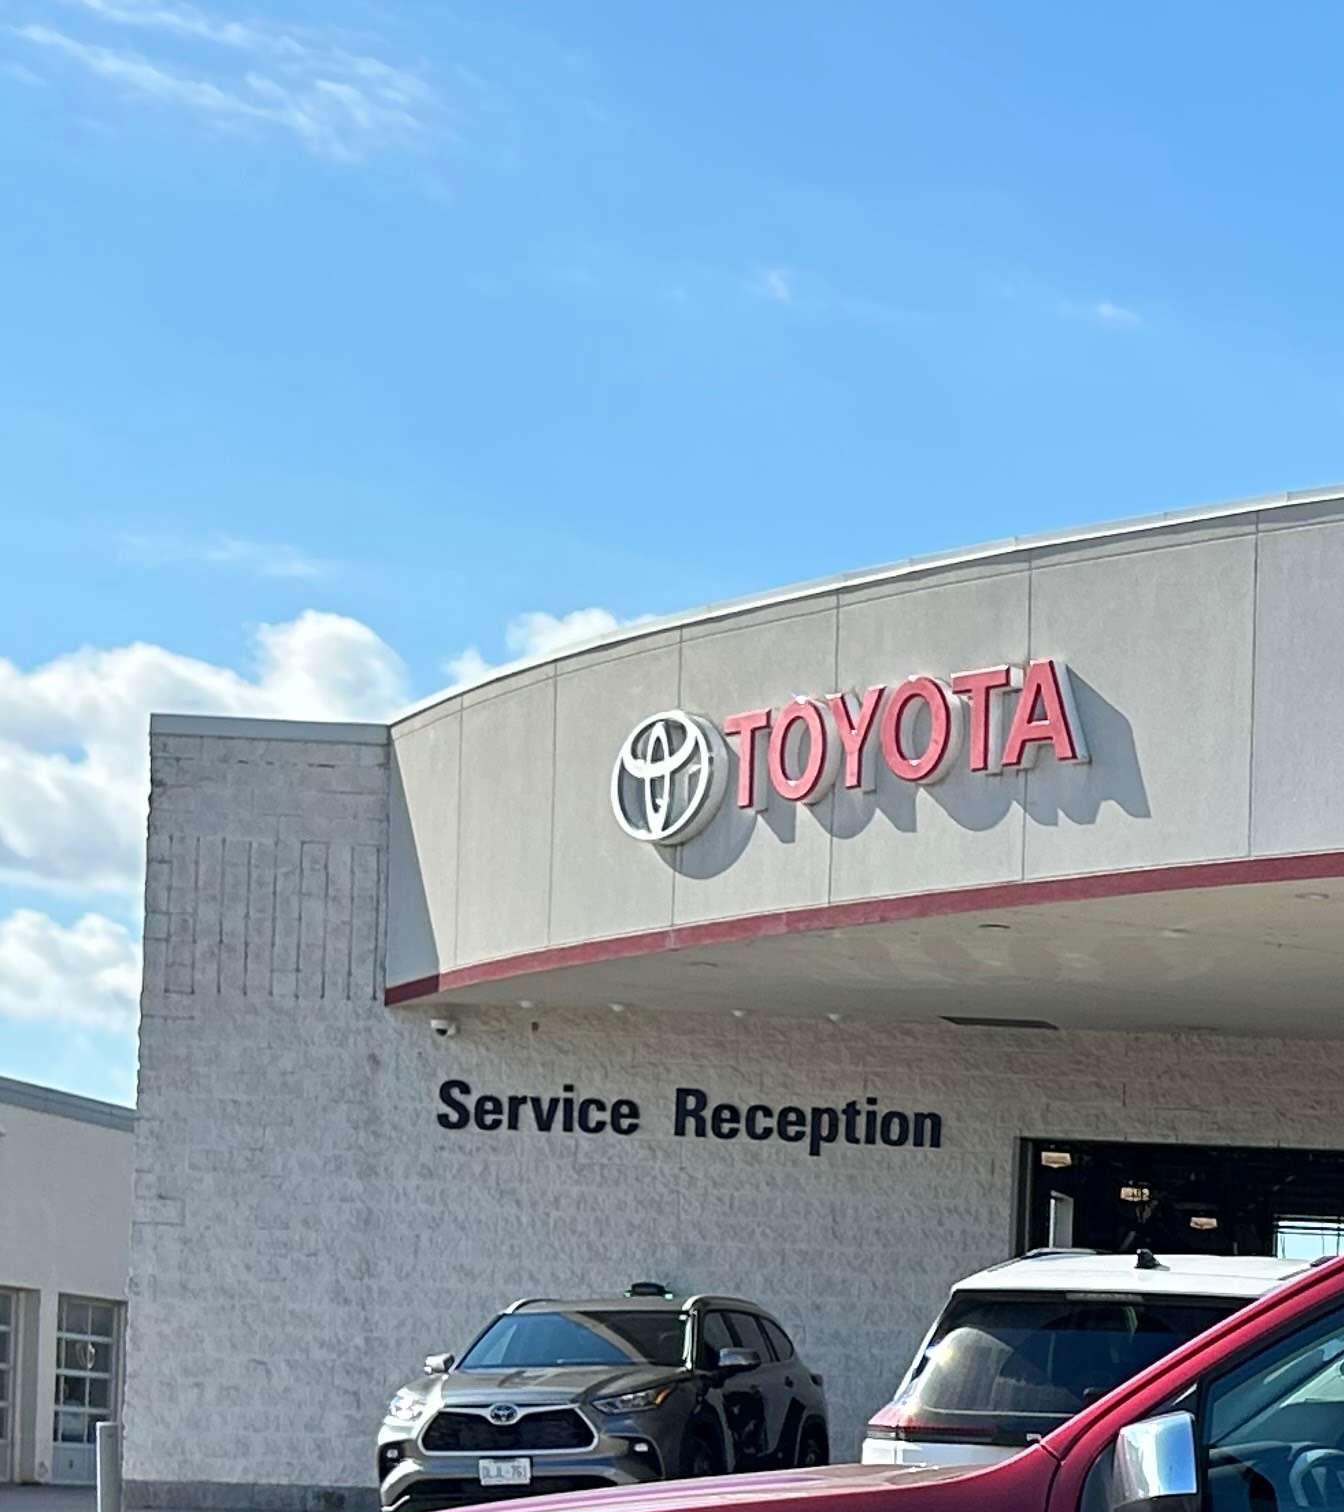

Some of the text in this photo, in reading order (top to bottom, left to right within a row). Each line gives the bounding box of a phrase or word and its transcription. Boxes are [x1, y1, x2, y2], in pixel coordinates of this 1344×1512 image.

[724, 658, 1090, 811] TOYOTA
[436, 1079, 943, 1157] Service Reception
